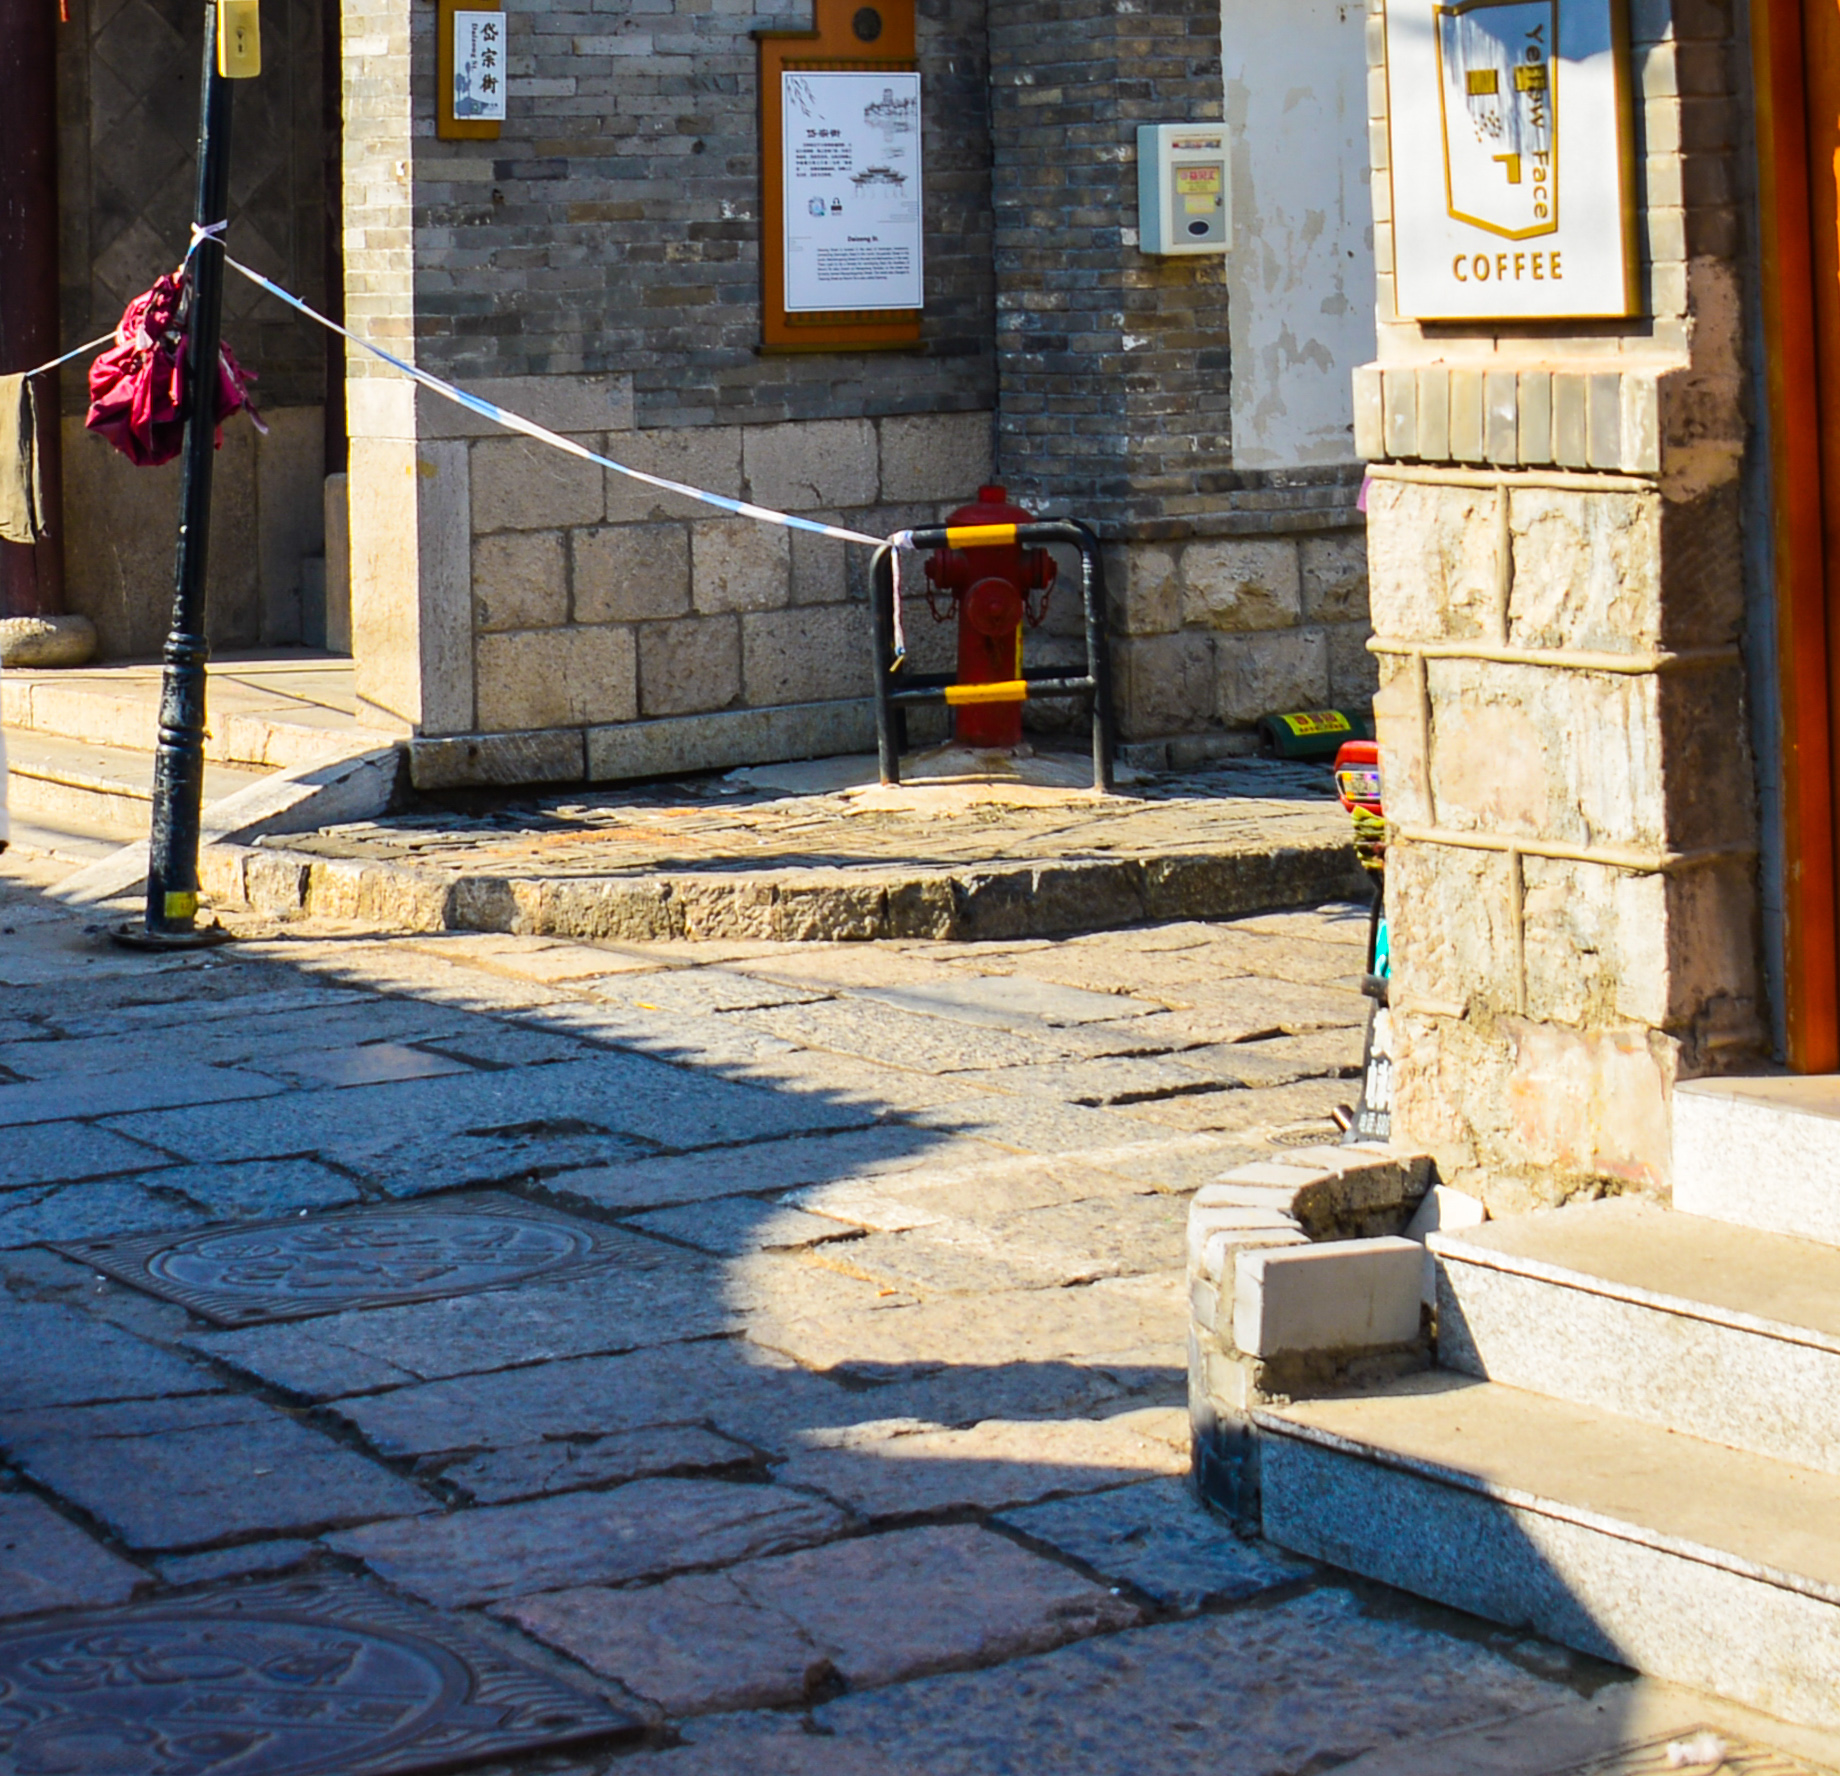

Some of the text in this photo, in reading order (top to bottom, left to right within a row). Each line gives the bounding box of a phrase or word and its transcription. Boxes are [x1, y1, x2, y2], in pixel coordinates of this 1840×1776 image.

[480, 21, 500, 94] 岱宗街
[1525, 24, 1549, 220] Yellow Face
[1452, 251, 1563, 282] COFFEE
